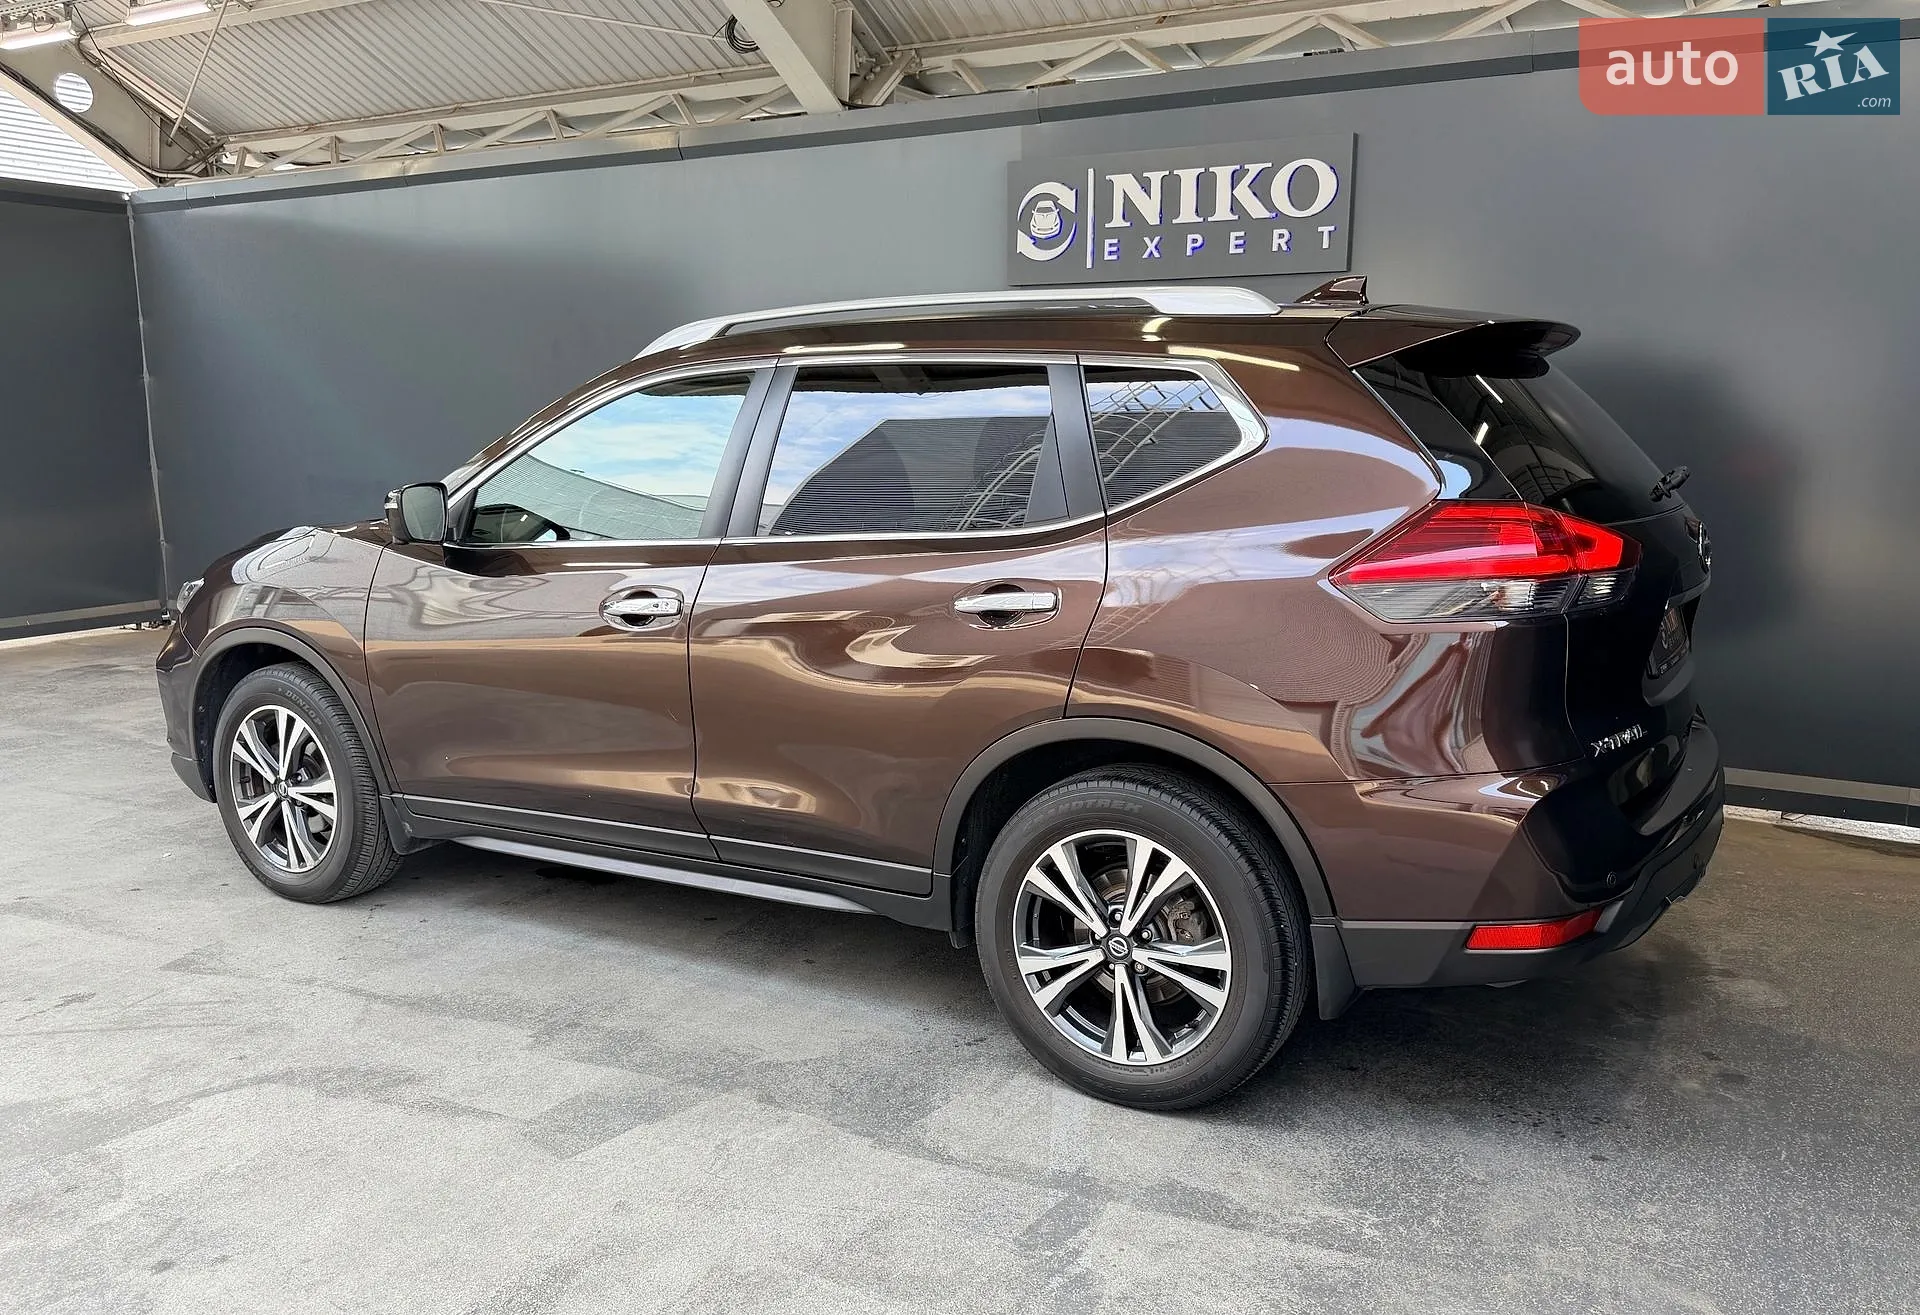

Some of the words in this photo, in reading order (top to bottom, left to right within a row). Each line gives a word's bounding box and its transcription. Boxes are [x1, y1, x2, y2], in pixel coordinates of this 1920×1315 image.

[1104, 158, 1339, 229] NIKO
[1104, 225, 1337, 262] EXPERT
[284, 689, 323, 726] DUNLOP
